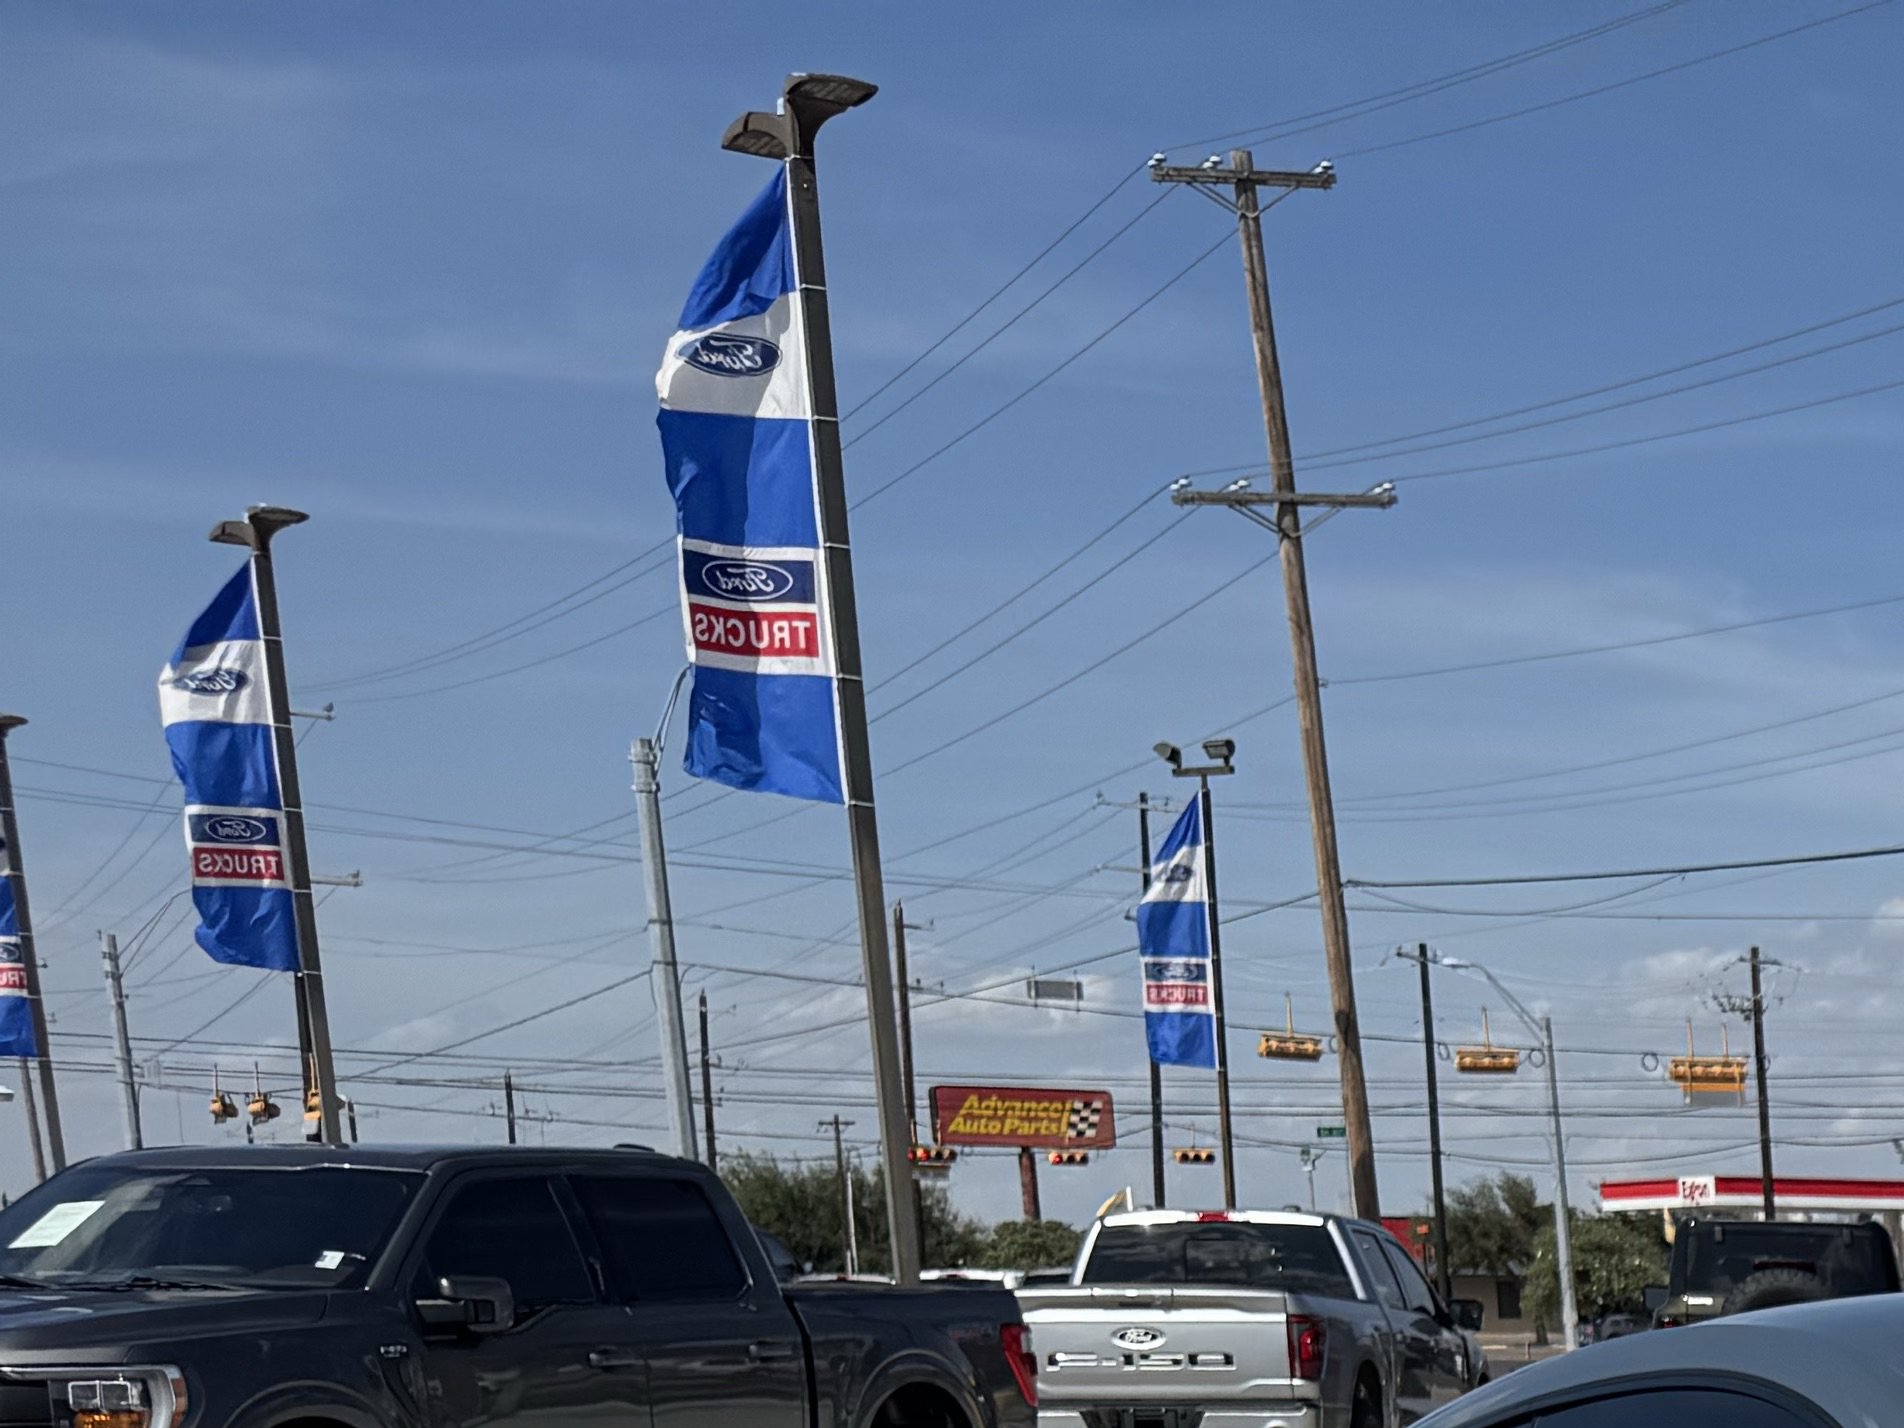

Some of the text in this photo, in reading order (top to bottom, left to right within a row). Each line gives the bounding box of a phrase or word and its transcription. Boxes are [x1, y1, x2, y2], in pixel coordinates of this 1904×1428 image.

[959, 1094, 1064, 1118] Advance
[948, 1116, 1058, 1136] Auto Parts
[1046, 1352, 1237, 1372] F-150
